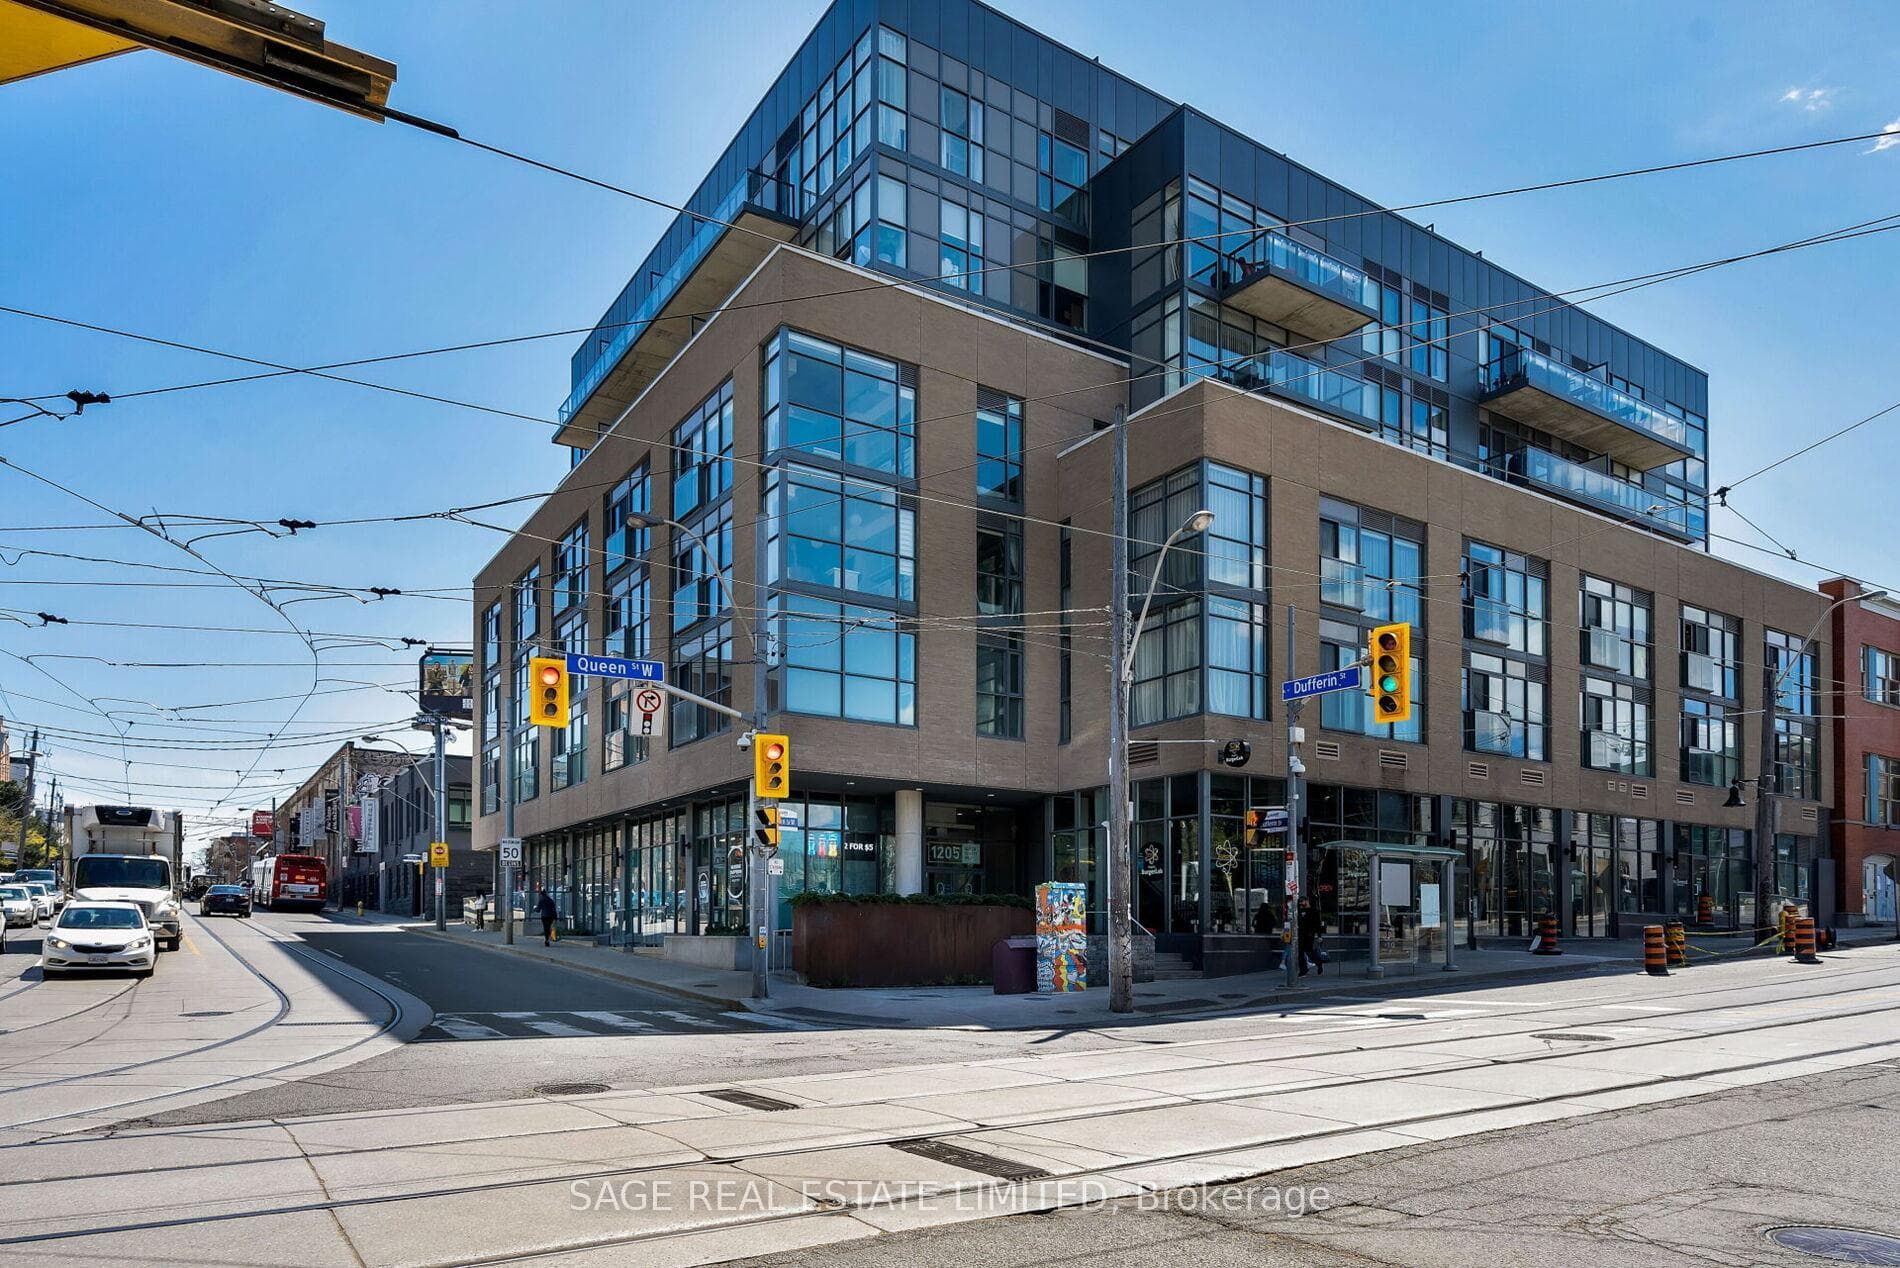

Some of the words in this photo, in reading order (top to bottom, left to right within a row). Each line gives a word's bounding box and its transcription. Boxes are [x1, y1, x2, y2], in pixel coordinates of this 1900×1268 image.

[577, 657, 626, 675] Queen
[631, 662, 639, 670] St
[641, 663, 653, 677] W
[1293, 675, 1337, 694] Dufferin
[1339, 672, 1346, 680] St
[503, 847, 519, 859] 50
[850, 842, 863, 850] FOR
[864, 843, 874, 851] $5
[931, 845, 960, 859] 1205
